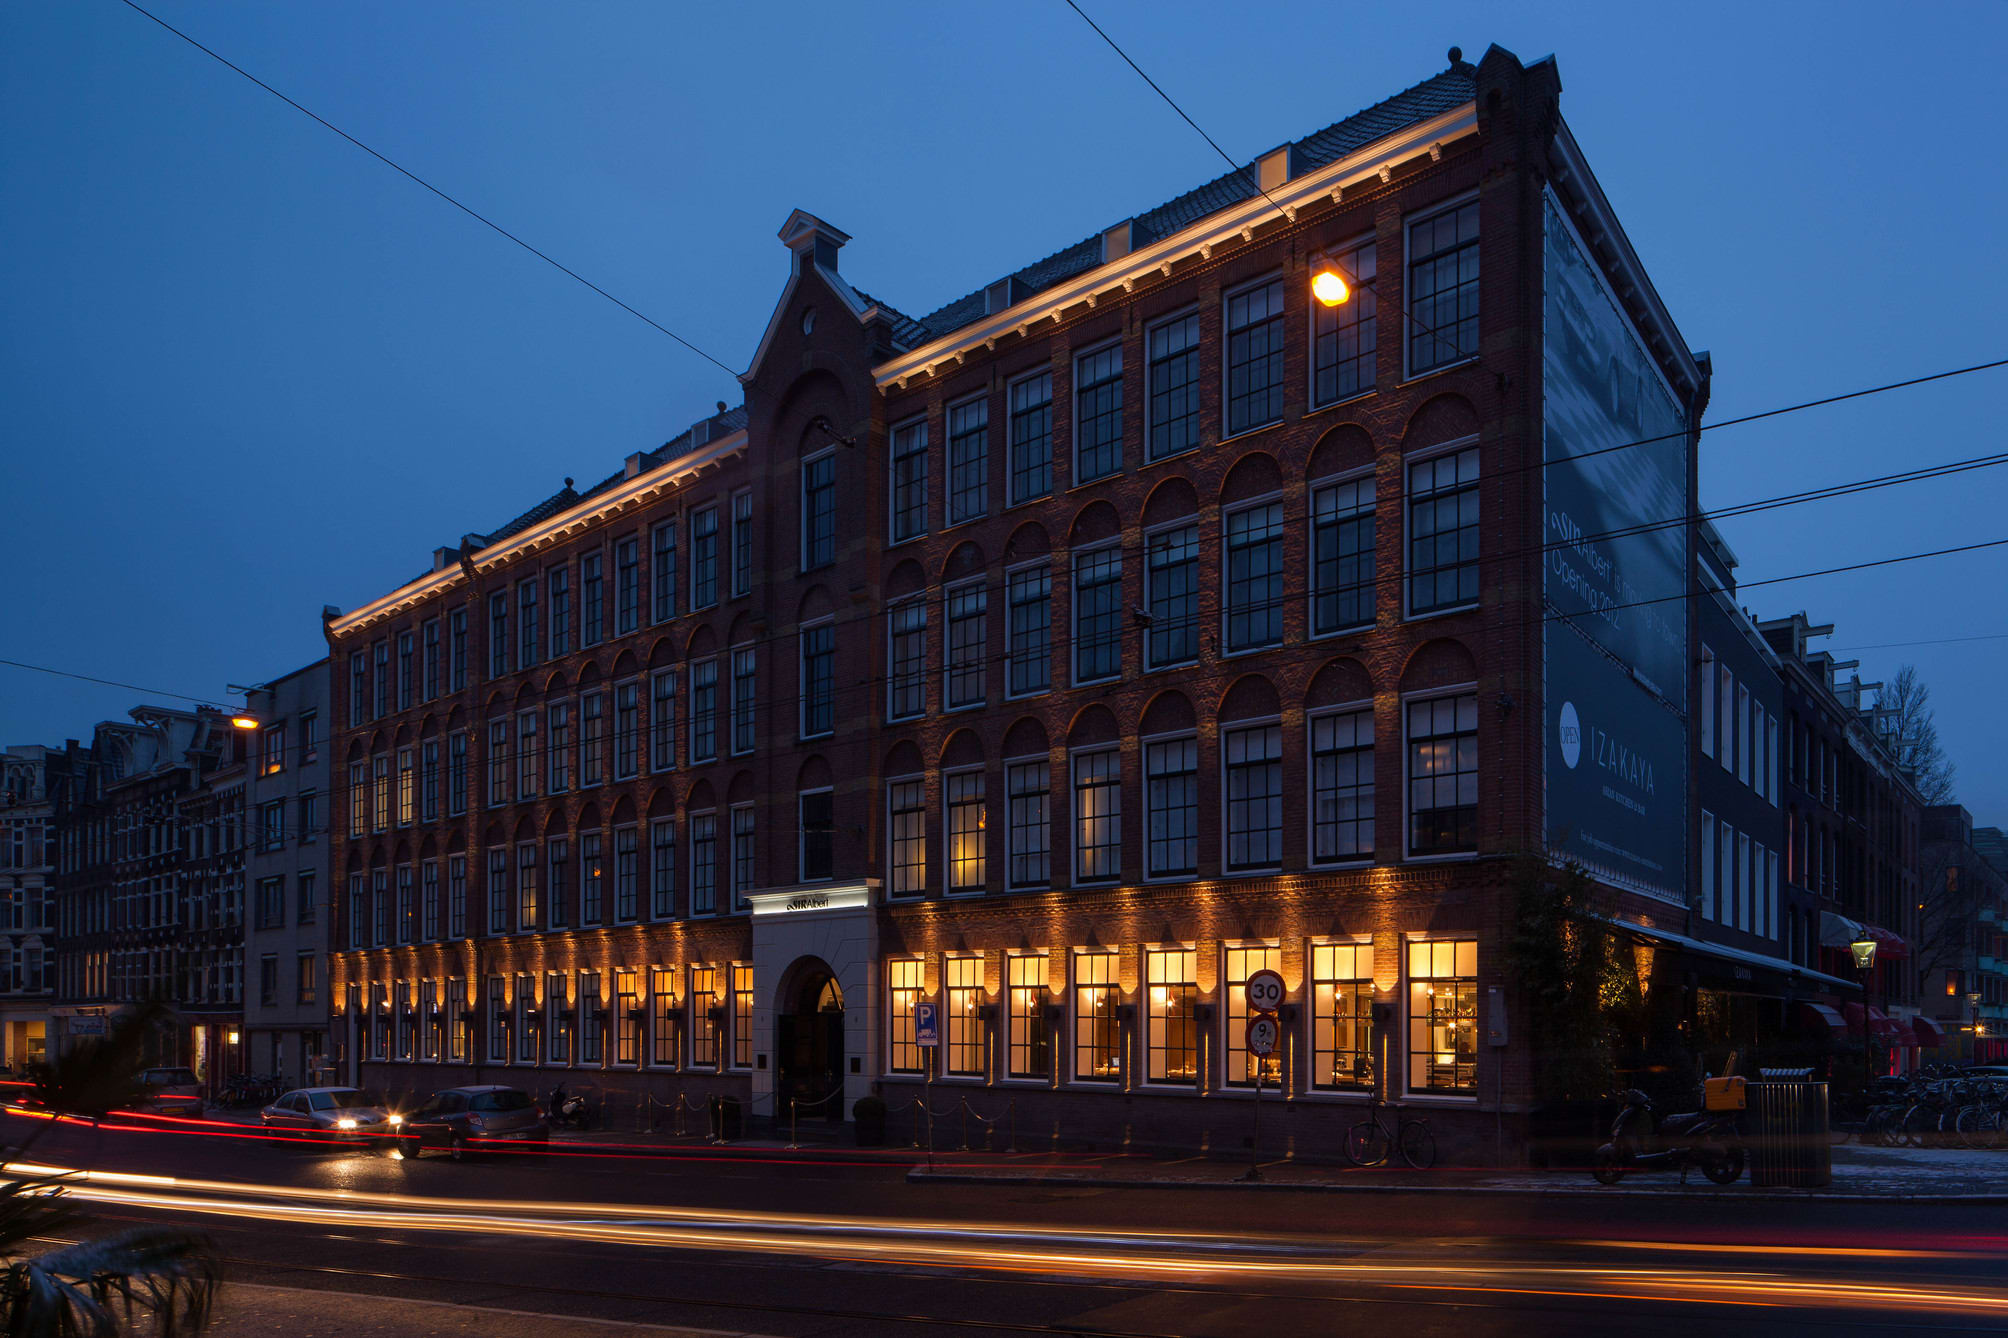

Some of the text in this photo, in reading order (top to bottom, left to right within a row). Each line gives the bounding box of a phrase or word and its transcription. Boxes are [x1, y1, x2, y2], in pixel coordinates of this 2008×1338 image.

[1552, 548, 1620, 630] Opening 2012
[1560, 726, 1580, 745] OPEN
[1591, 725, 1655, 796] IZAKAYA
[1253, 983, 1279, 1000] 30
[919, 1006, 932, 1025] P
